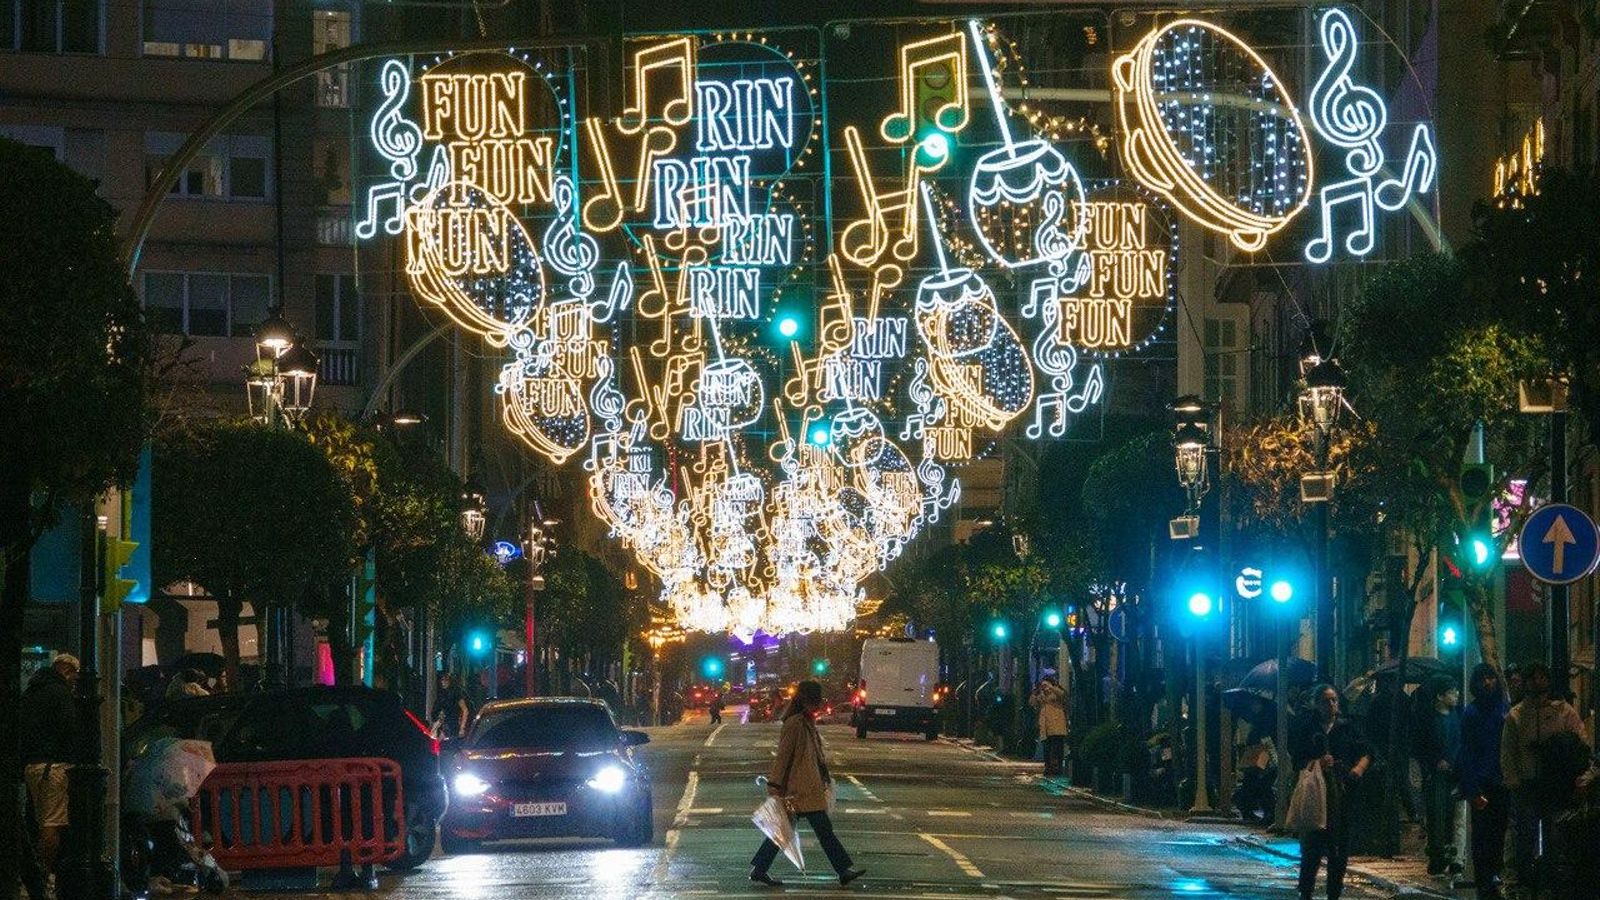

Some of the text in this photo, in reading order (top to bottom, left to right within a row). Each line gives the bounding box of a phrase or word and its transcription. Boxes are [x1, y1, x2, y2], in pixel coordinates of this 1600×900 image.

[421, 71, 526, 140] FUN
[694, 77, 793, 151] RIN
[449, 137, 553, 207] FUN
[653, 155, 751, 229] RIN
[721, 214, 793, 266] RIN
[1071, 202, 1146, 250] FUN
[689, 268, 760, 320] RIN
[1090, 250, 1165, 299] FUN
[850, 317, 907, 359] RIN
[1057, 298, 1132, 347] FUN
[824, 359, 881, 401] RIN
